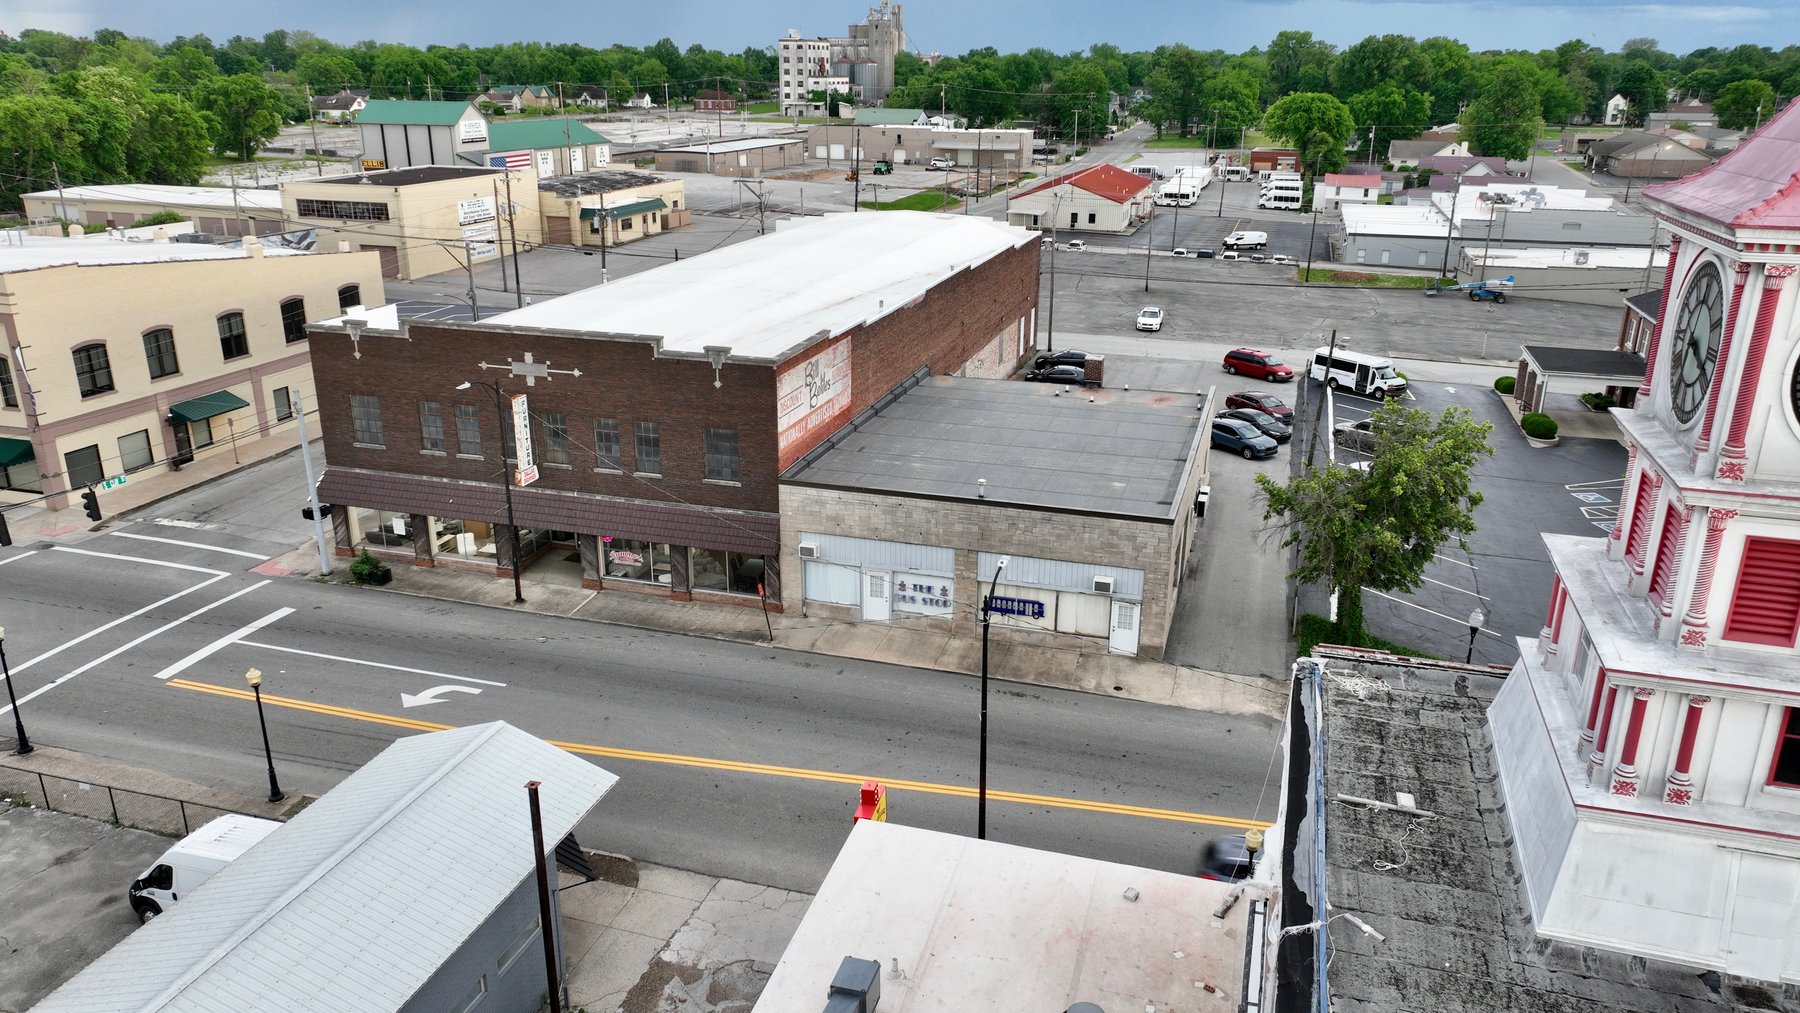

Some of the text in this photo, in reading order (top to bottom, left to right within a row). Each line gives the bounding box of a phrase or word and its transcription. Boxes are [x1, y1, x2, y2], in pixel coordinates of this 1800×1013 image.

[779, 390, 803, 414] DISCOUNT
[521, 400, 531, 466] FURNITURE
[911, 583, 935, 595] THE
[921, 597, 952, 608] STOP
